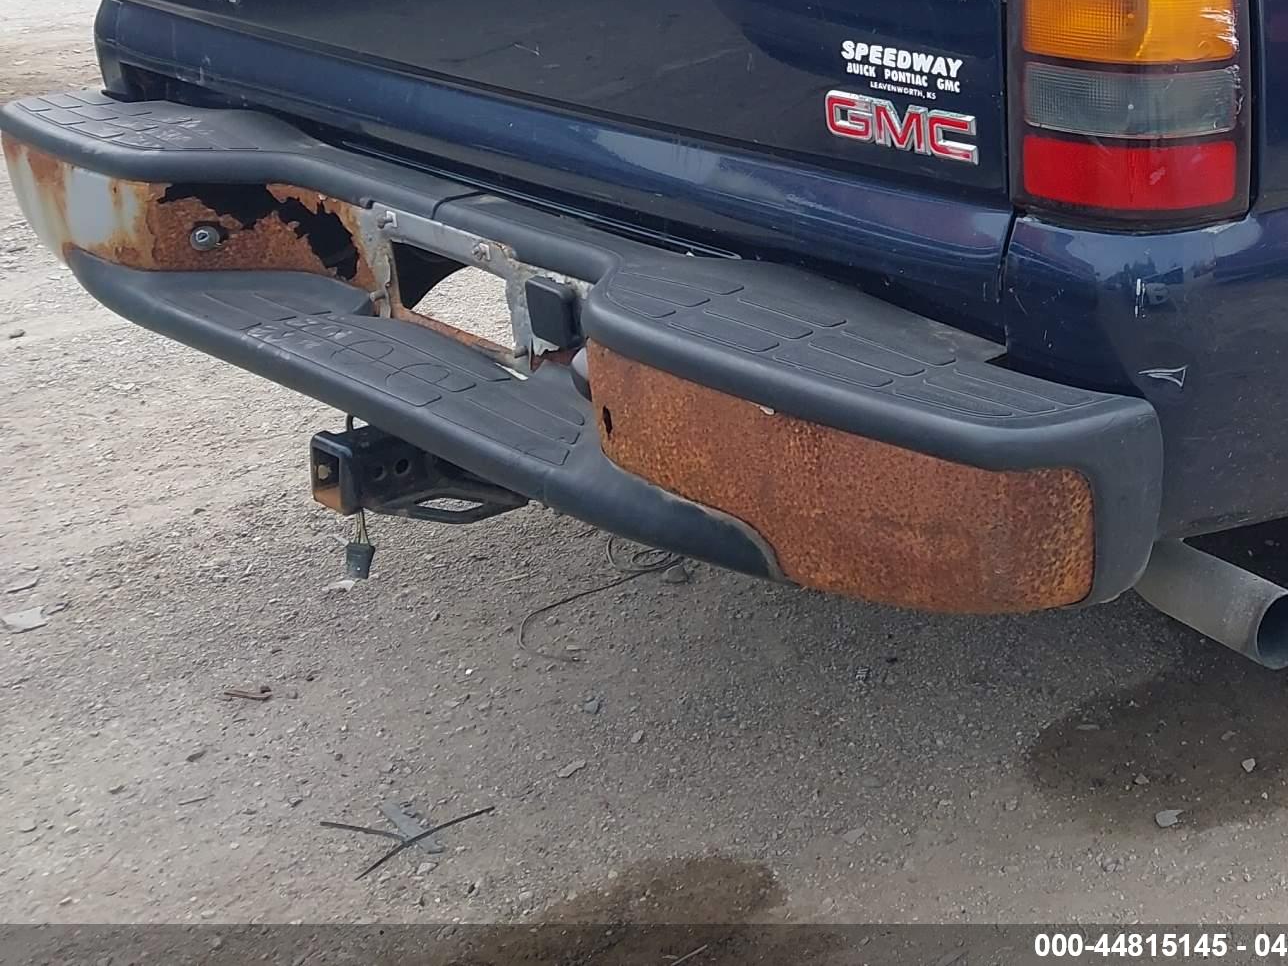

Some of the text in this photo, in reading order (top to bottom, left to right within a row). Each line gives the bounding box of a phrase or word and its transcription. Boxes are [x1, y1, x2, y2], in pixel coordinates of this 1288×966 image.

[840, 40, 963, 78] SPEEDWAY
[846, 62, 961, 93] BUICK PONTIAC GMC
[869, 81, 937, 100] LEAVENWORTH, KS
[825, 89, 979, 165] GMC
